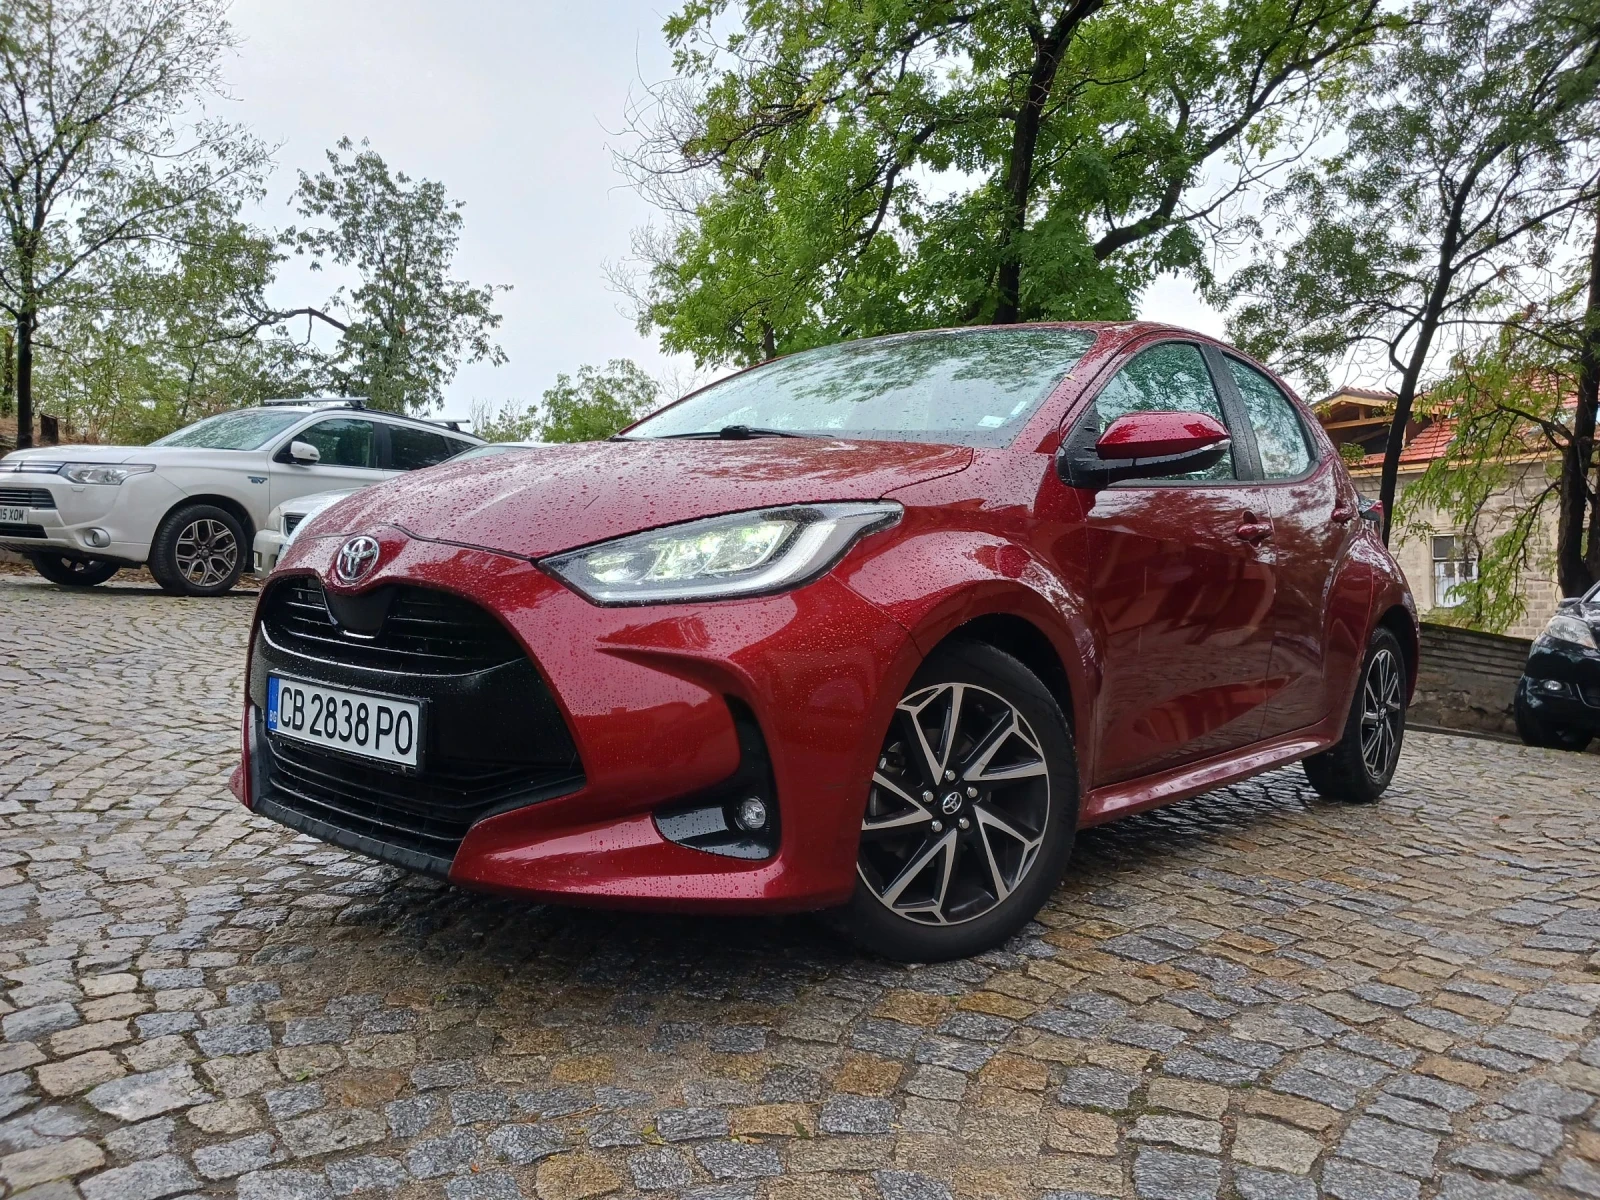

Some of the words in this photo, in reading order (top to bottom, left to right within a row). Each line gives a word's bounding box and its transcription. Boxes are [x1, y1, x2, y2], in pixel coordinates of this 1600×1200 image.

[269, 709, 278, 722] BG
[280, 686, 305, 731] CB
[309, 693, 369, 746] 2838
